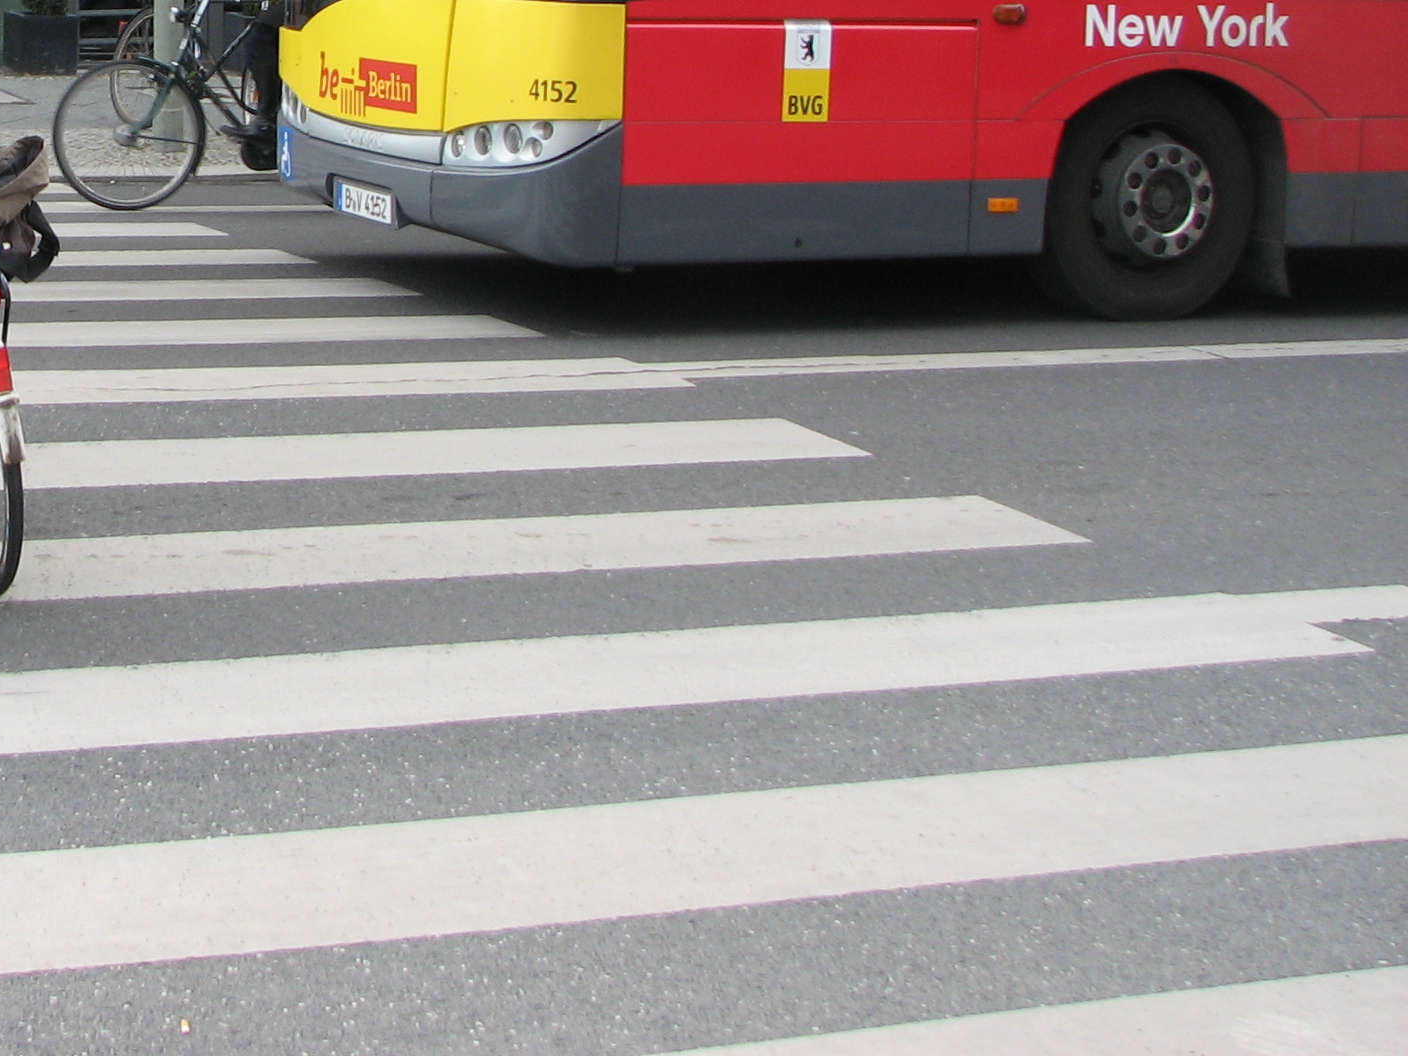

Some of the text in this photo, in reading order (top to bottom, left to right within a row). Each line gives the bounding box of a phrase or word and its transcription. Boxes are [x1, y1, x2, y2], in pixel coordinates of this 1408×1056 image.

[1084, 2, 1290, 48] New York
[319, 51, 412, 104] be Berlin
[529, 78, 578, 104] 4152
[787, 95, 824, 116] BVG
[364, 193, 387, 219] 4152
